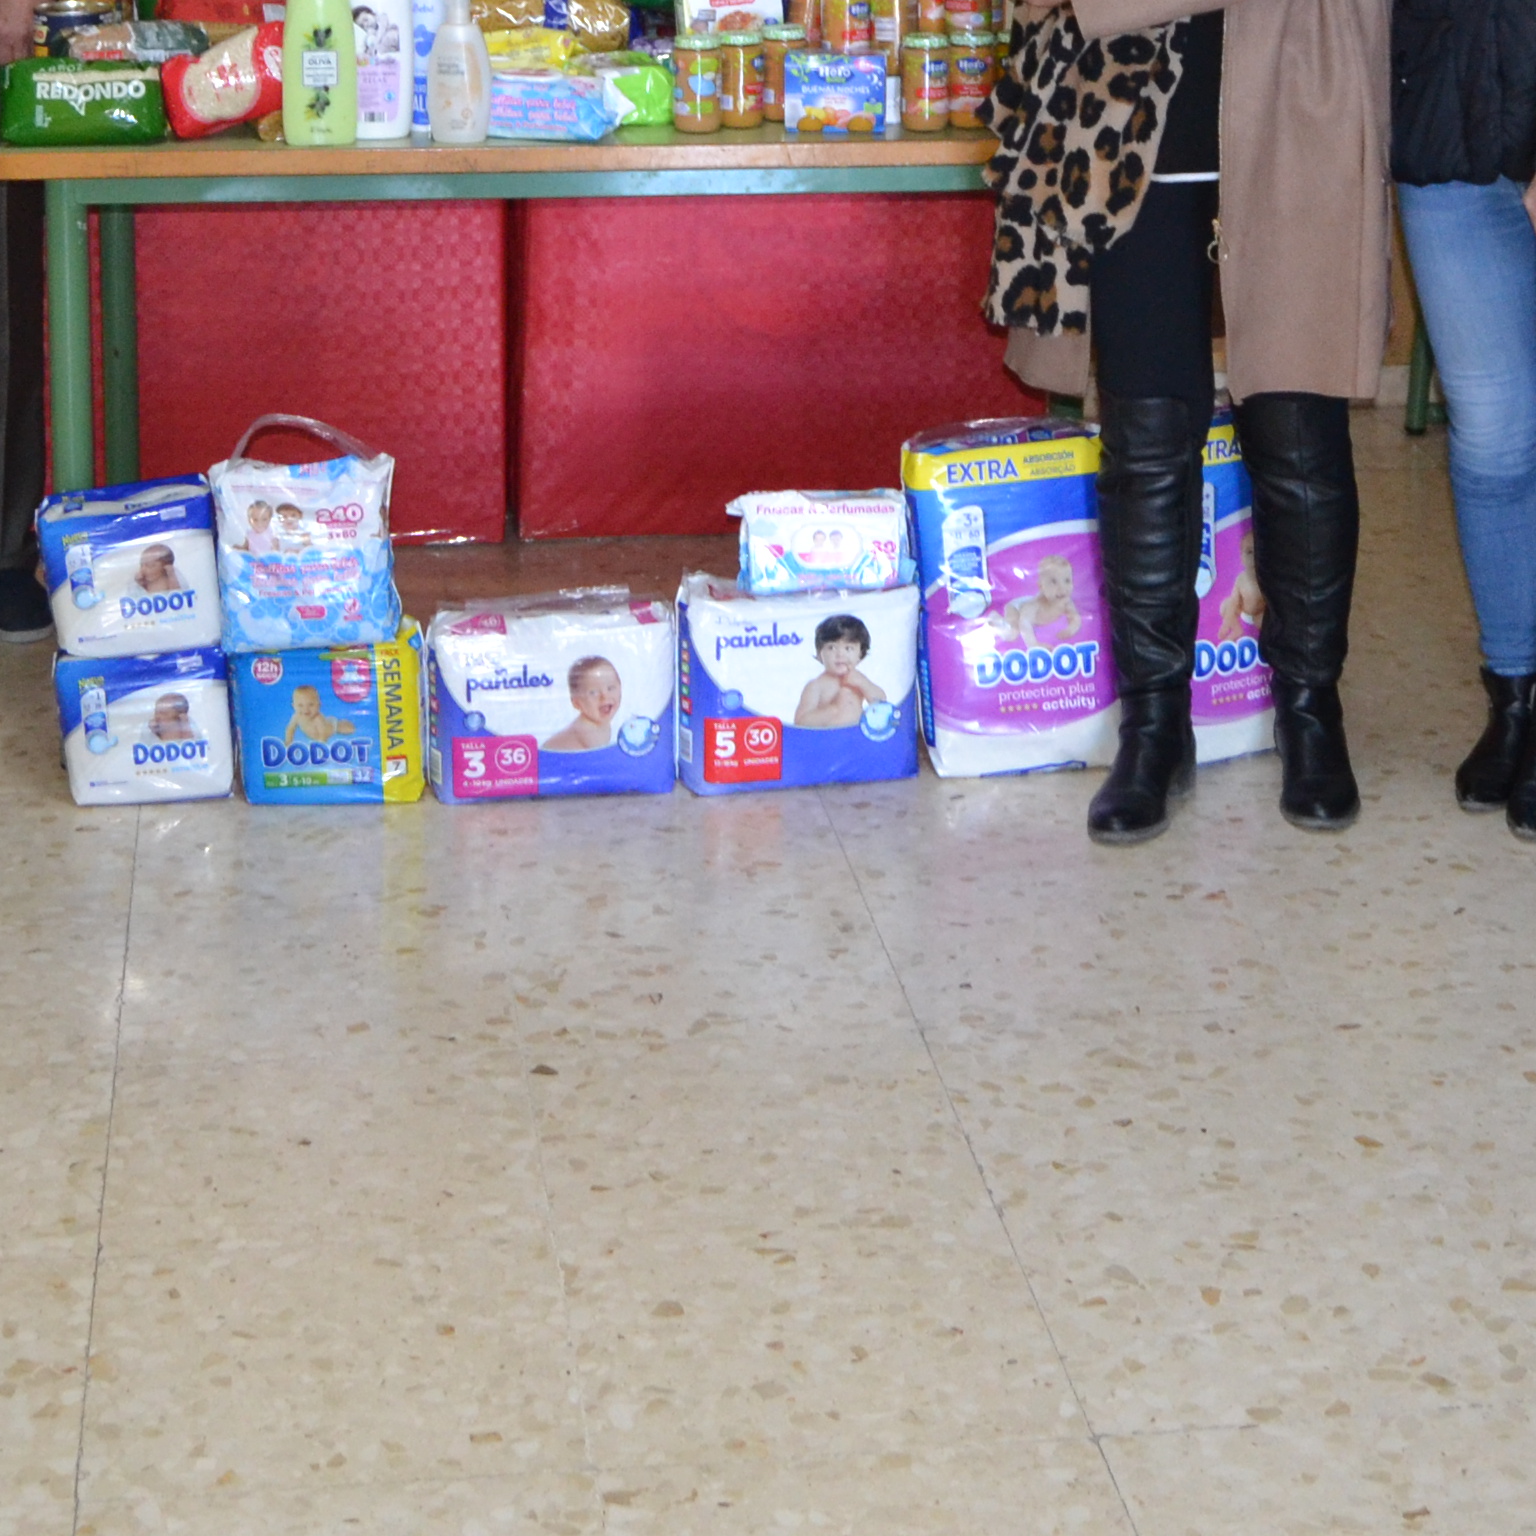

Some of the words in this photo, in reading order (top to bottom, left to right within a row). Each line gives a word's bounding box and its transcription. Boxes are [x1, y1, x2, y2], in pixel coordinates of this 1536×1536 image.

[308, 58, 332, 66] OLIVA
[819, 65, 852, 78] Hero
[35, 79, 146, 102] REDONDO
[801, 84, 840, 94] BUENAS
[841, 85, 870, 95] NOCHES
[1205, 440, 1242, 461] TRA
[946, 457, 1019, 485] EXTRA
[1023, 449, 1075, 465] ABSORCIÓN
[316, 502, 364, 523] 240
[119, 589, 196, 619] DODOT
[715, 622, 804, 662] pañales
[256, 662, 278, 673] 12h
[976, 642, 1097, 686] DODOT
[466, 663, 554, 704] pañales
[998, 685, 1065, 704] protection
[1068, 681, 1096, 696] plus
[382, 657, 404, 751] SEMANA
[1042, 695, 1096, 711] activity
[132, 739, 209, 765] DODOT
[262, 737, 372, 768] DODOT
[714, 731, 737, 758] 5
[748, 729, 774, 745] 30
[392, 760, 401, 771] 7
[463, 750, 486, 778] 3
[500, 747, 526, 764] 36
[743, 756, 779, 766] UNIDADES
[279, 773, 288, 787] 3
[495, 777, 534, 786] UNIDADES
